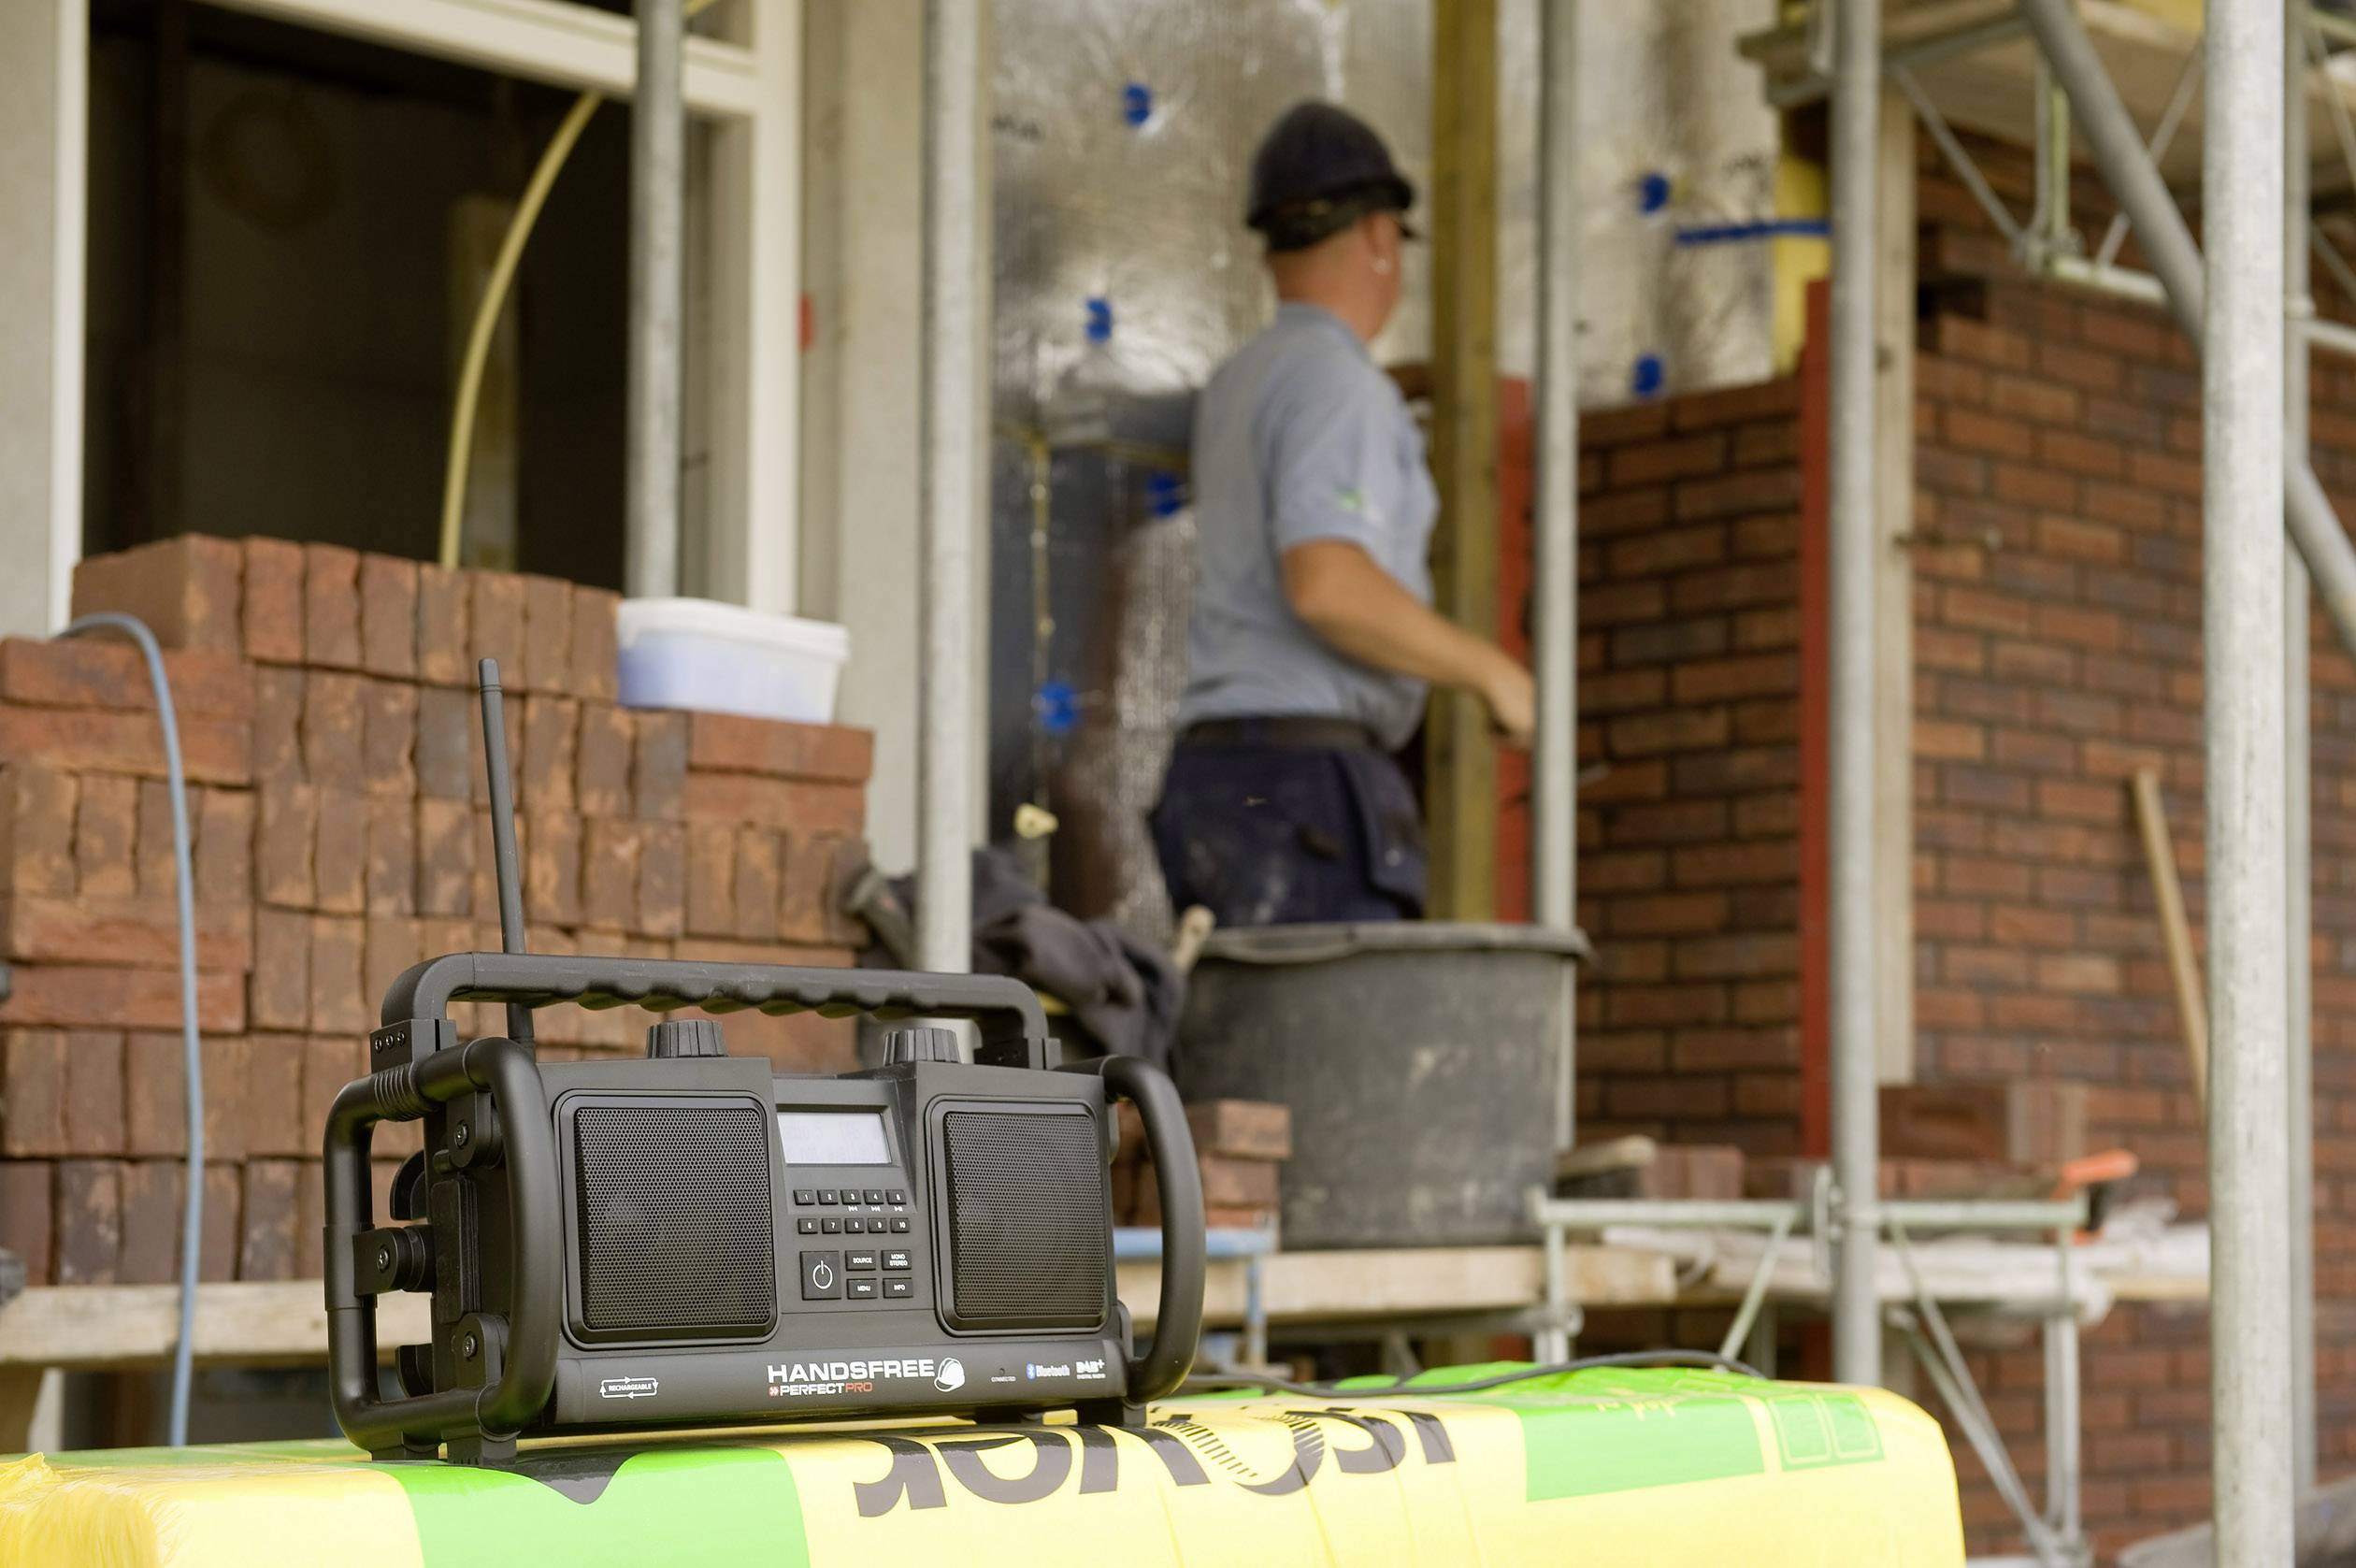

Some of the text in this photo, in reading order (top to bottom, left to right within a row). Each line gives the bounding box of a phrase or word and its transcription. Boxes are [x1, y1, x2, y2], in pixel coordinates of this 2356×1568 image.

[767, 1359, 936, 1384] HANDSFREE
[1036, 1364, 1070, 1377] Bluetooth
[1075, 1359, 1105, 1374] DAB+
[608, 1383, 653, 1392] RECHARGEABLE
